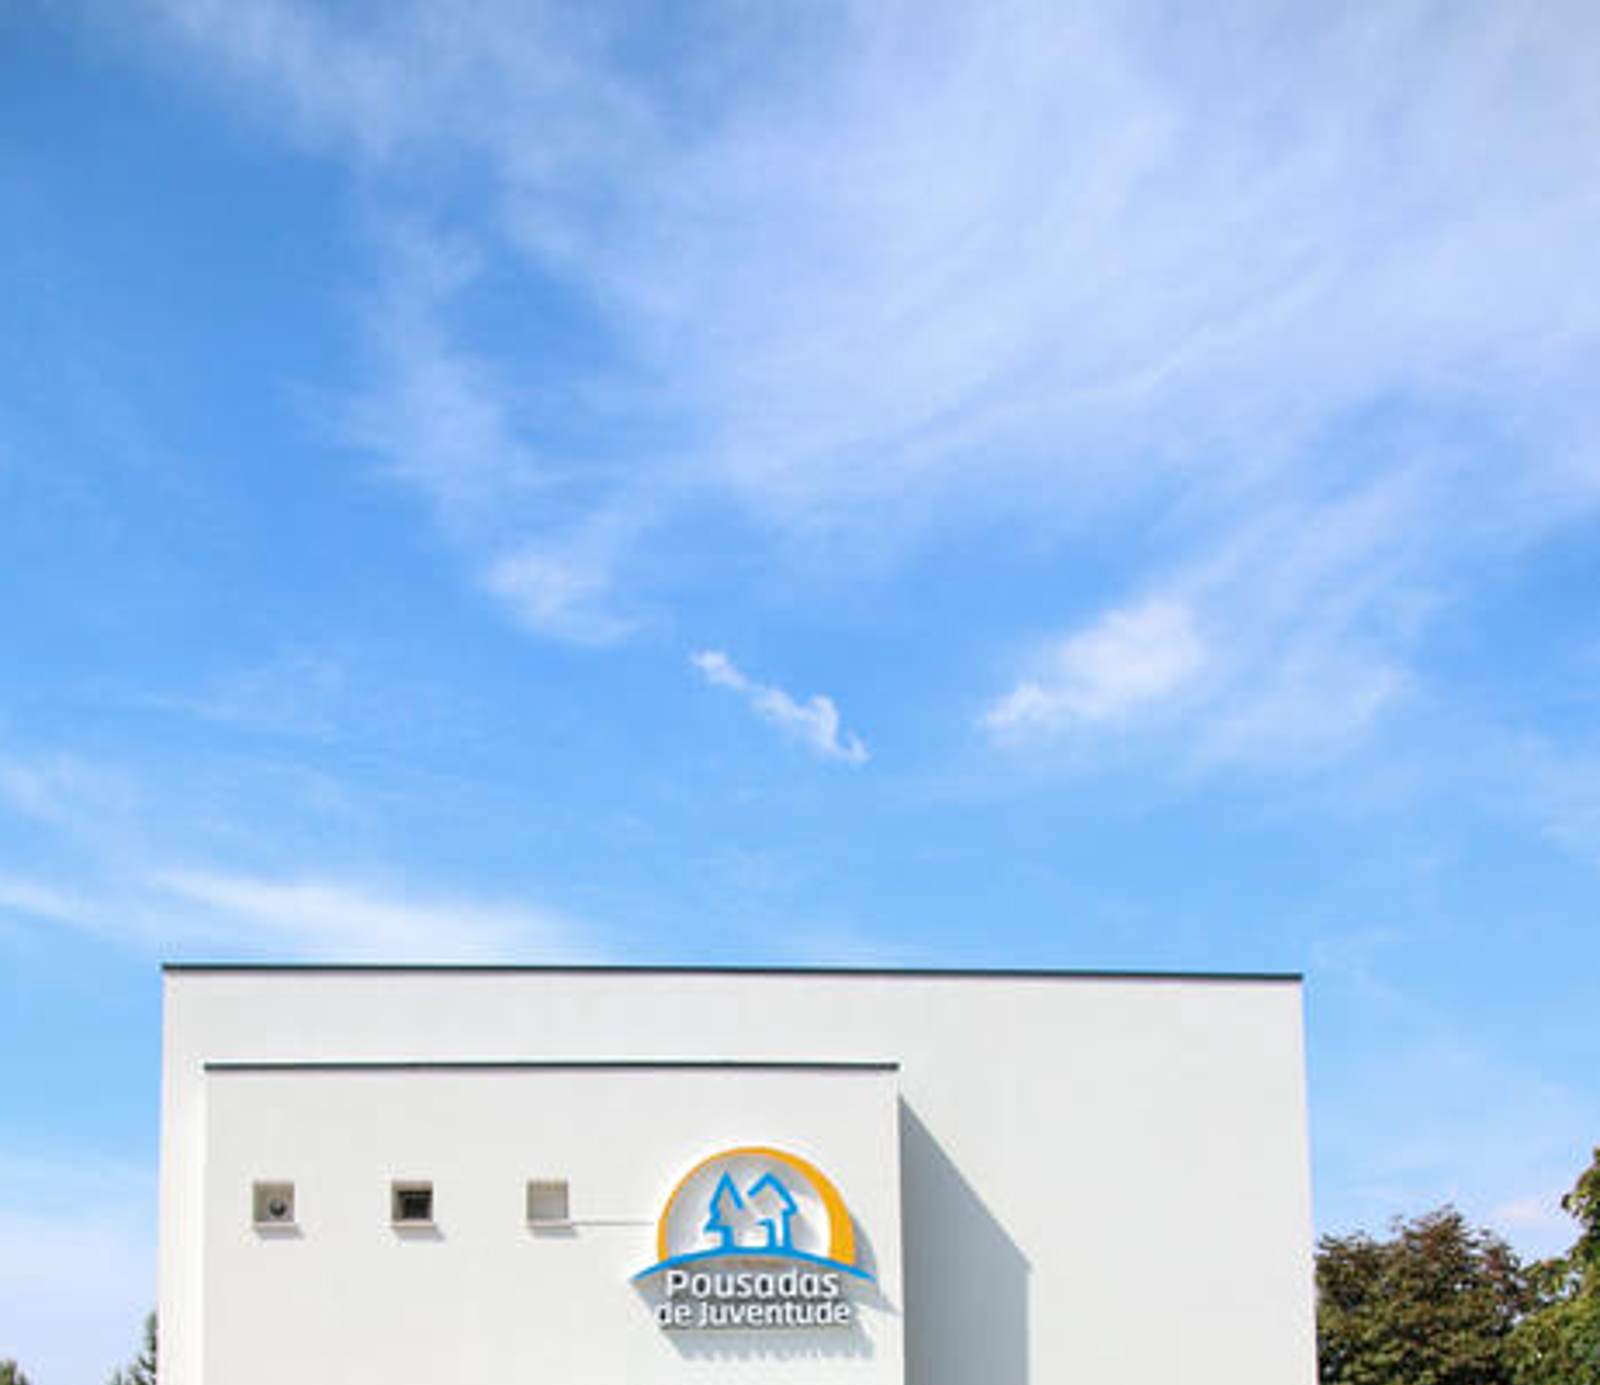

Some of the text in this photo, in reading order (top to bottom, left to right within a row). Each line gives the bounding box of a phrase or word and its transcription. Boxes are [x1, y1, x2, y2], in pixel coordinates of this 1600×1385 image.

[666, 1267, 839, 1298] Pousadas
[656, 1301, 850, 1328] de Juventude
